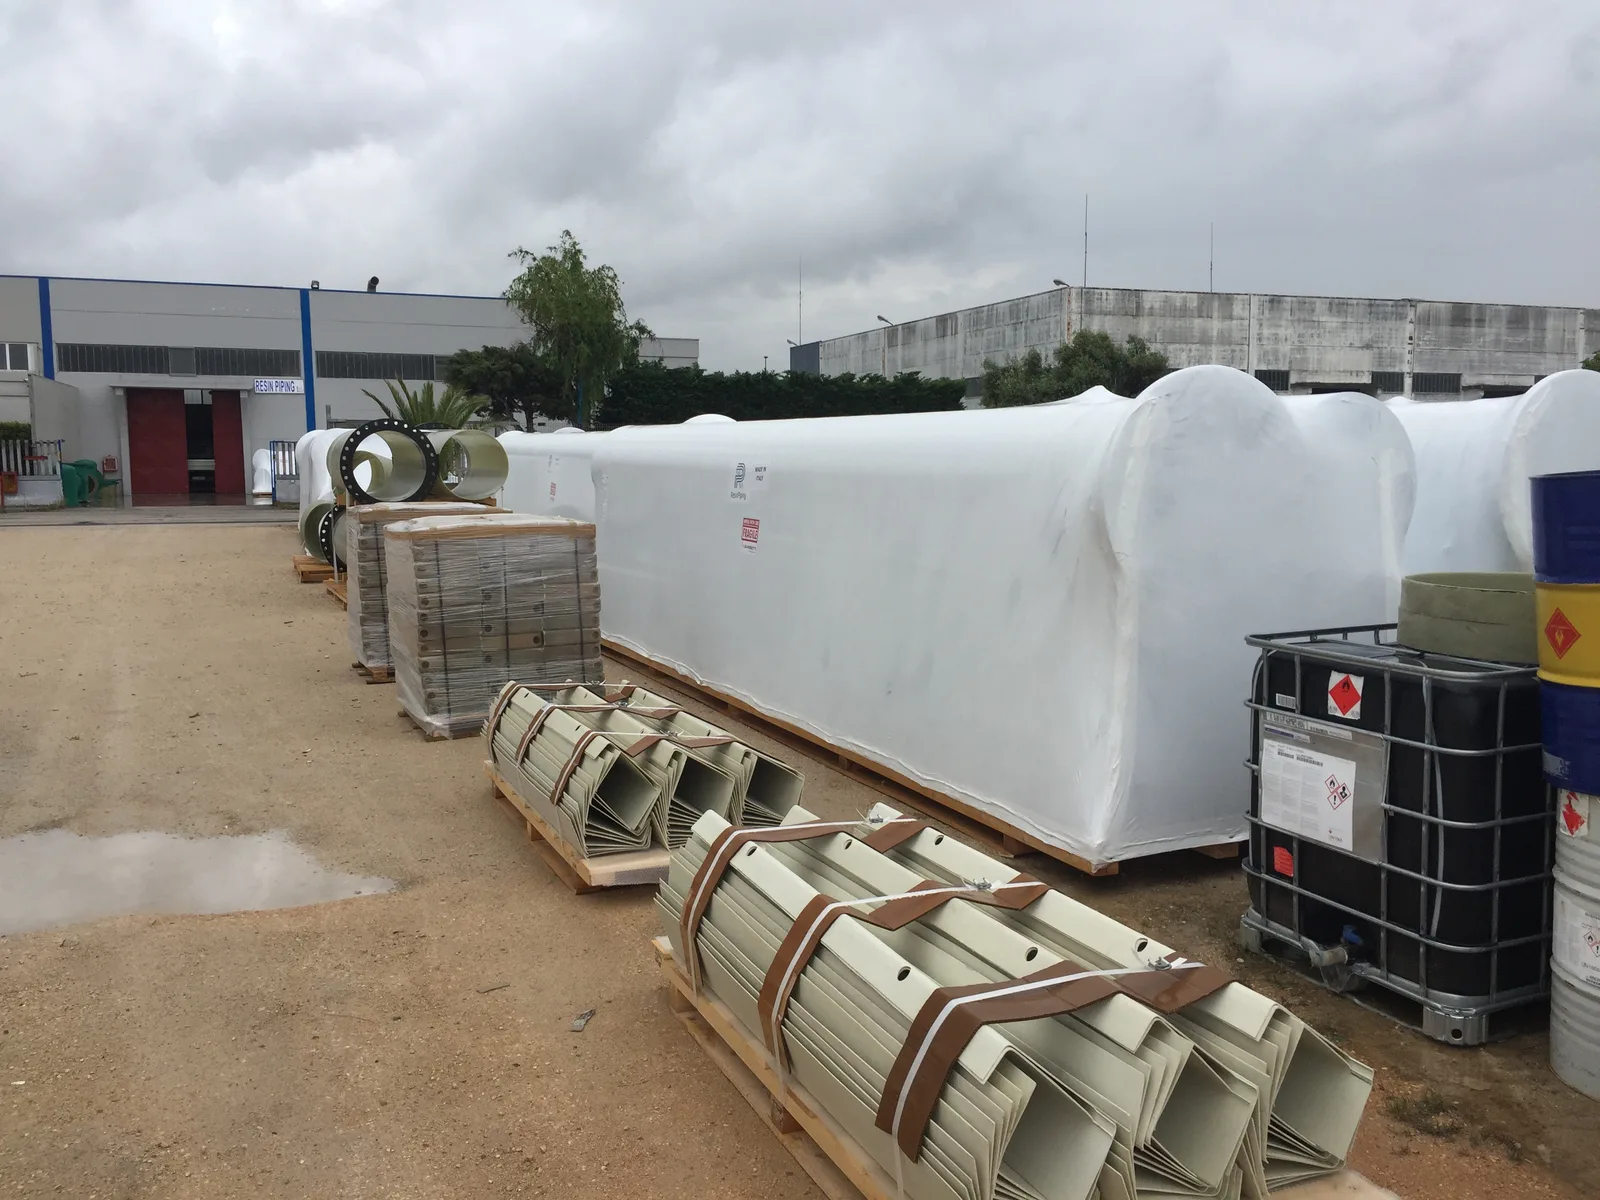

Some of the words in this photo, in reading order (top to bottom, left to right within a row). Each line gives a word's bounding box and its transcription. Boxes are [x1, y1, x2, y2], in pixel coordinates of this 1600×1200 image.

[255, 380, 273, 391] RESIN
[275, 380, 295, 392] PIPING
[743, 528, 758, 539] FRAGILE
